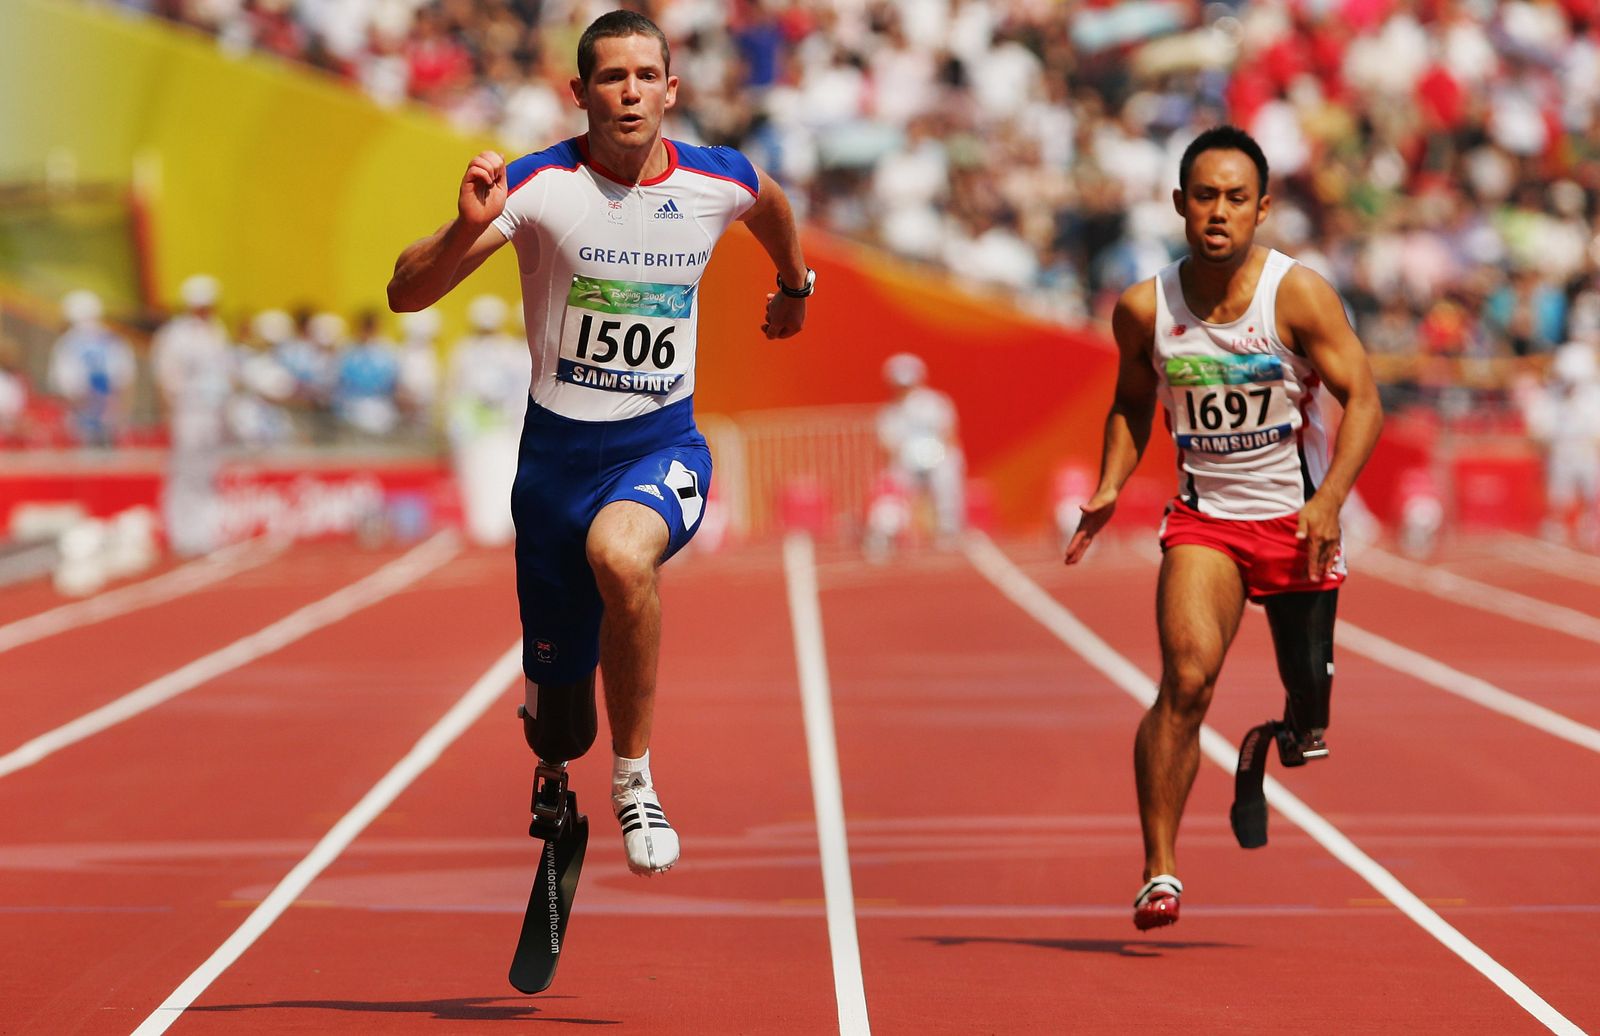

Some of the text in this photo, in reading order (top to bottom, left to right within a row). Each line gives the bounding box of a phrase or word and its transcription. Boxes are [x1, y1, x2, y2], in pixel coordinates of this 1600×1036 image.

[653, 211, 684, 220] adidas
[642, 291, 666, 303] 2008
[575, 313, 676, 370] 1506
[1185, 387, 1272, 430] 1697
[1189, 428, 1281, 452] SAMSUNG
[546, 841, 560, 954] www.dorset-ortho.com
